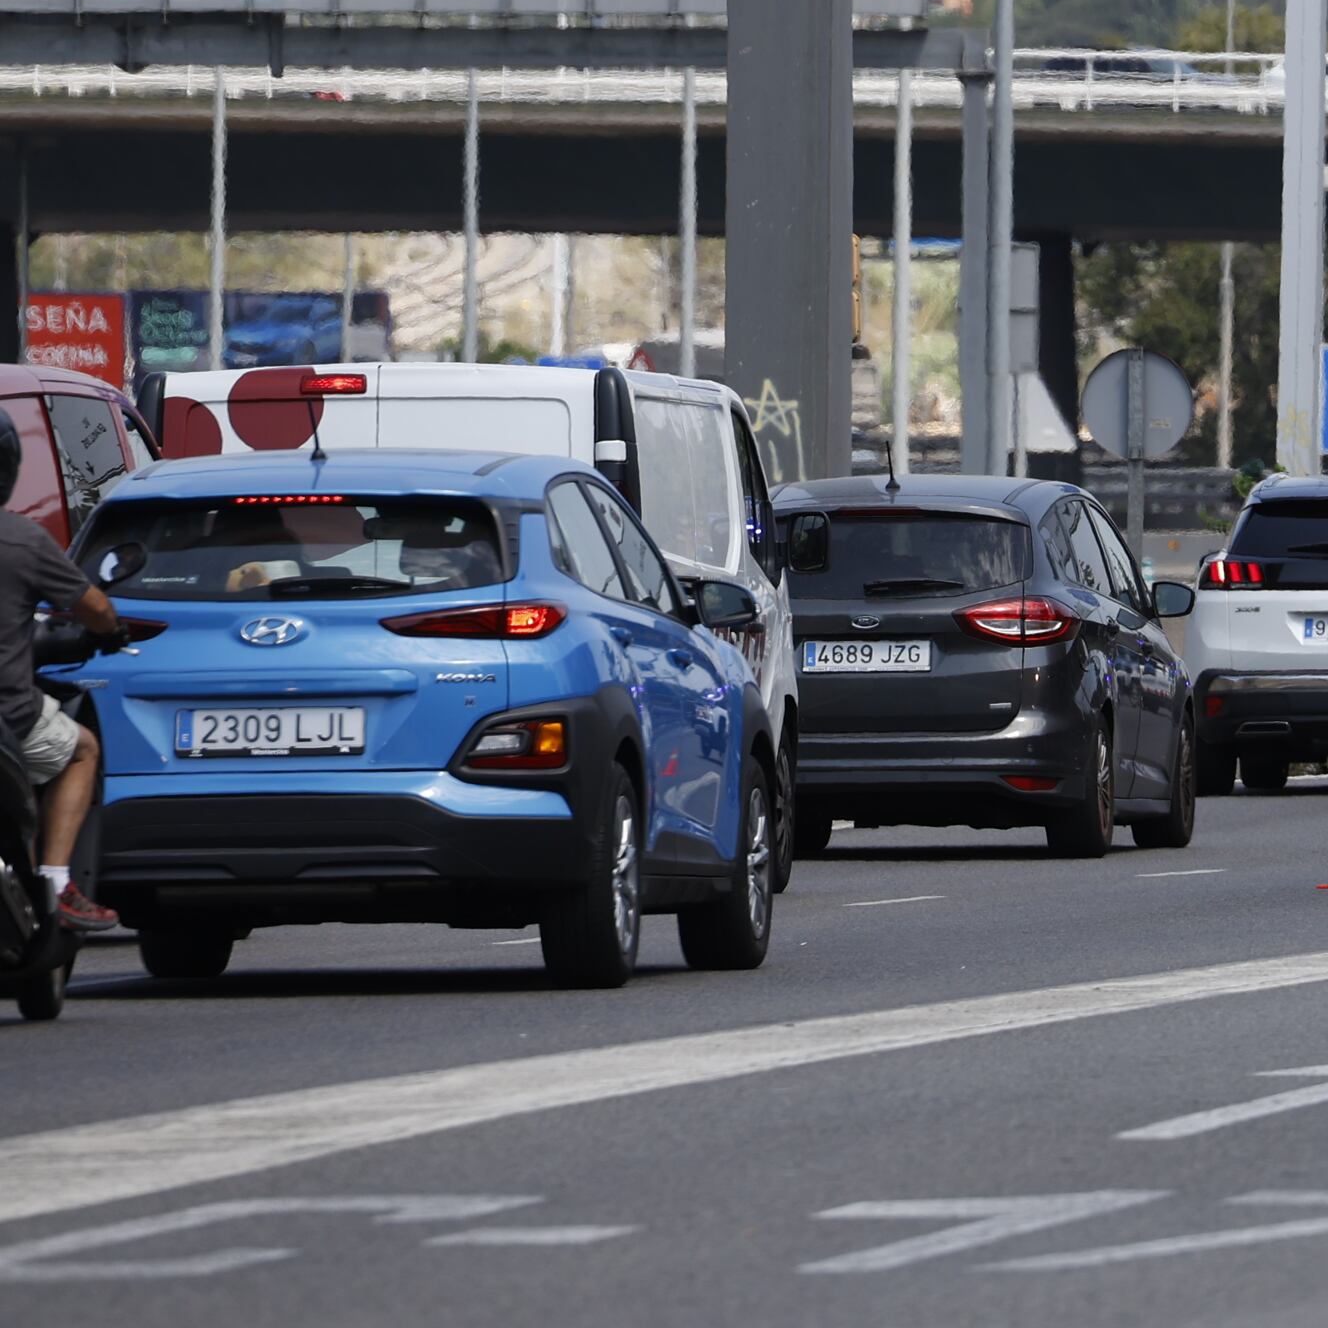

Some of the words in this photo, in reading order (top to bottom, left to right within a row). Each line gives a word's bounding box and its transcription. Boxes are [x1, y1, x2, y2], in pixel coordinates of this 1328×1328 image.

[818, 644, 873, 663] 4689
[881, 644, 921, 663] JZG
[436, 673, 496, 683] KONA
[202, 715, 281, 743] 2309
[296, 713, 355, 742] LJL
